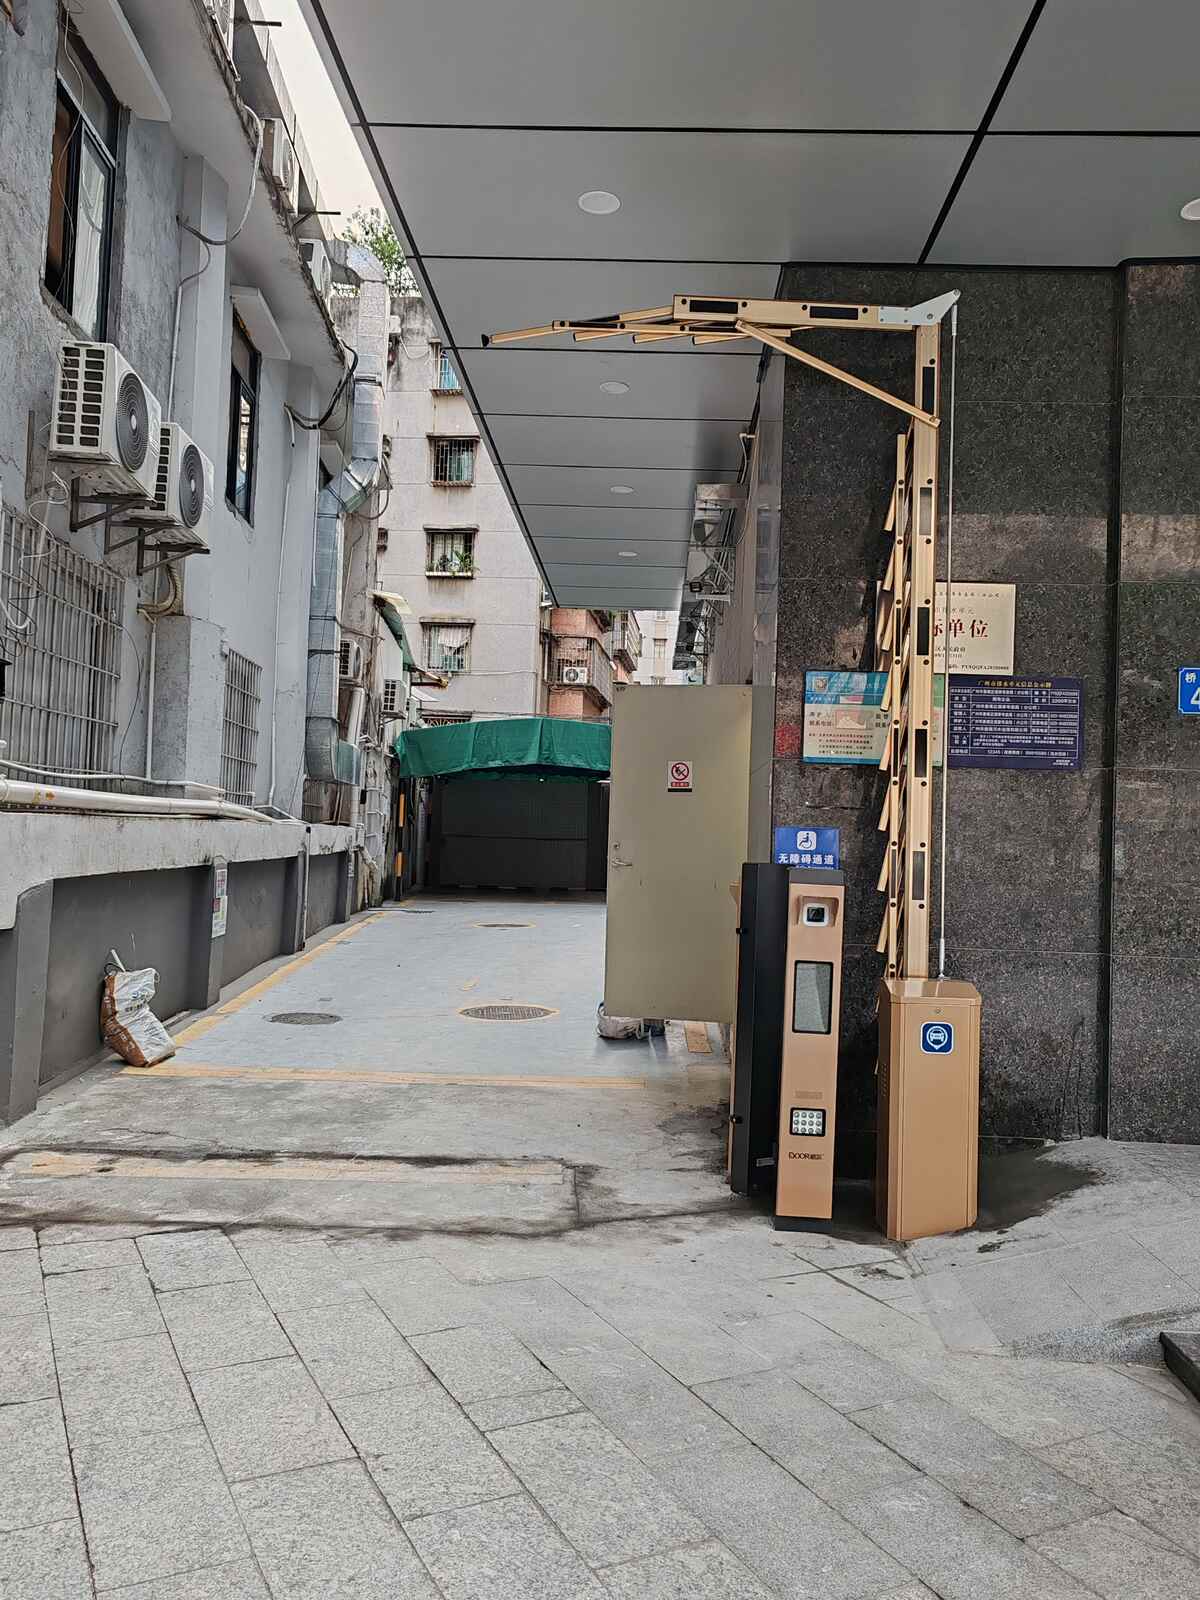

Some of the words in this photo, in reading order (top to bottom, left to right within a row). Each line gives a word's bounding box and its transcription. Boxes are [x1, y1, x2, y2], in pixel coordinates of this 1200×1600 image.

[778, 853, 834, 865] 无障碍通道
